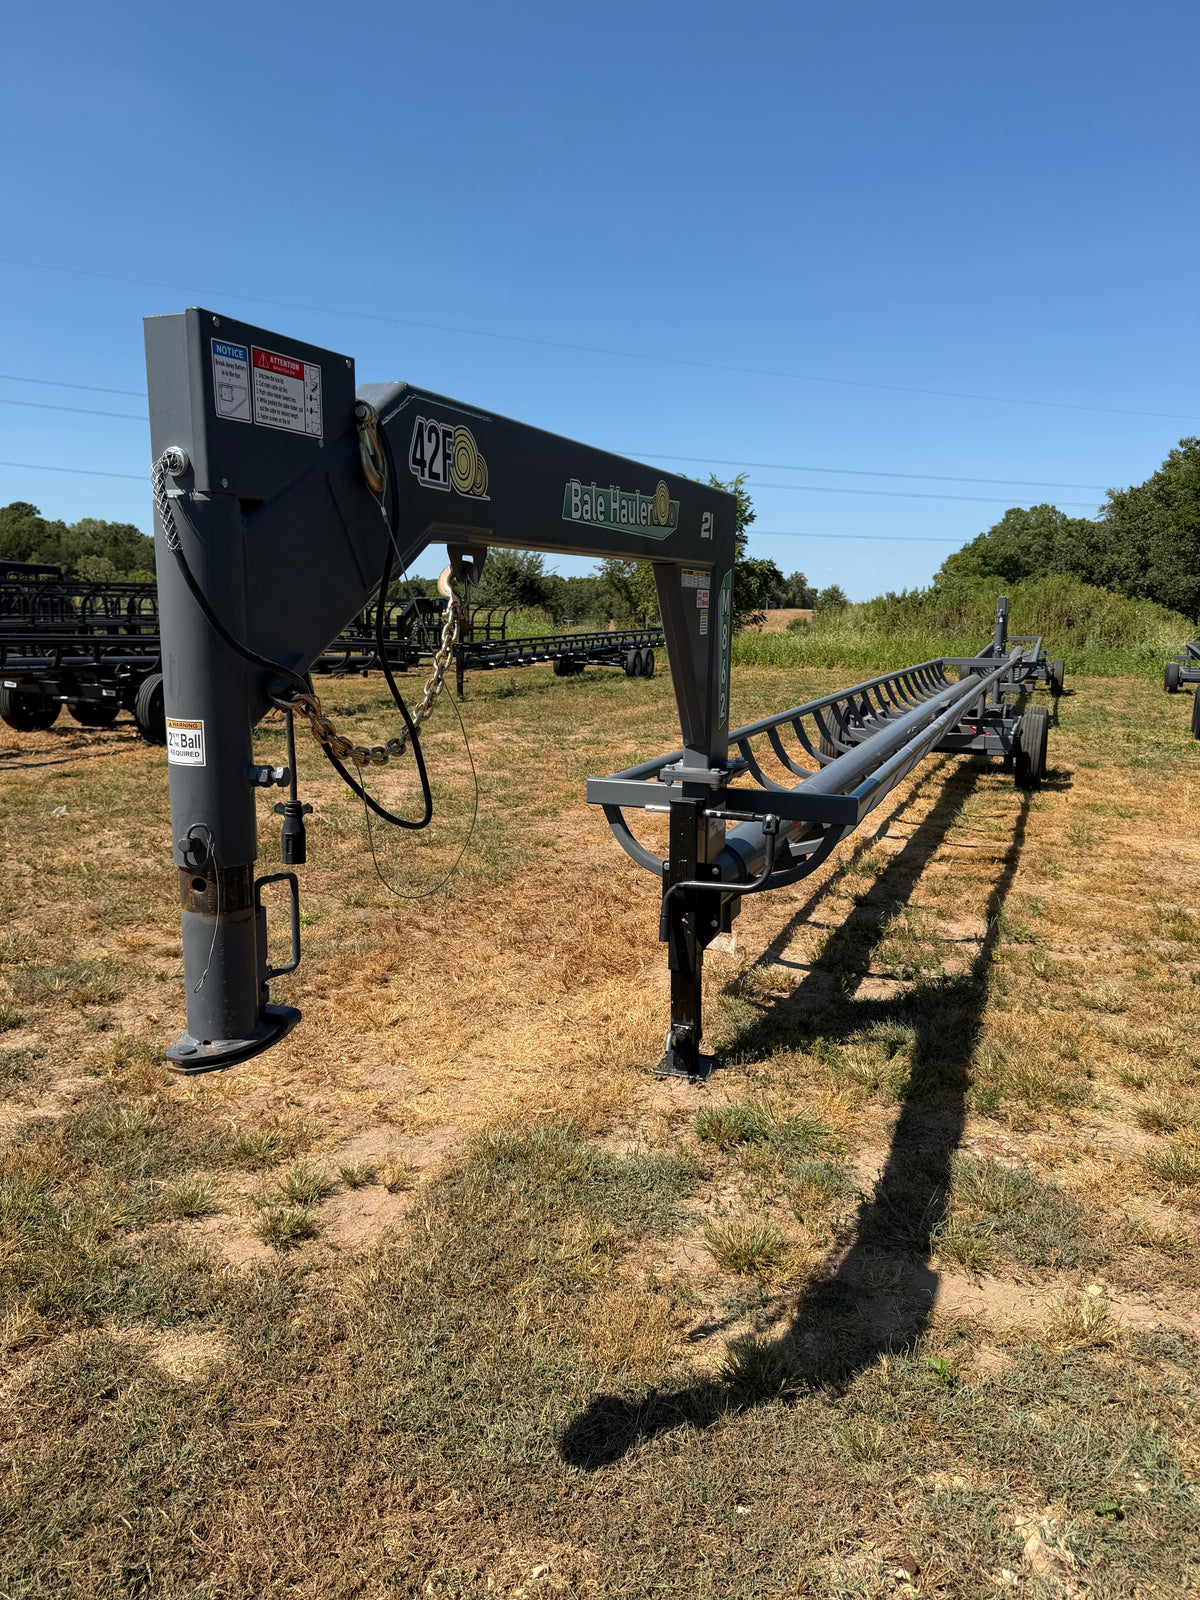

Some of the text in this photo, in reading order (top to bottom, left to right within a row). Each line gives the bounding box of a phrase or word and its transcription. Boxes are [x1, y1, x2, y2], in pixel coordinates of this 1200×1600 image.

[216, 344, 244, 359] NOTICE
[270, 356, 300, 371] ATTENTION
[411, 418, 453, 486] 42F
[570, 480, 653, 526] Bale Hauler
[180, 734, 200, 749] Ball
[170, 749, 200, 758] REQUIRED
